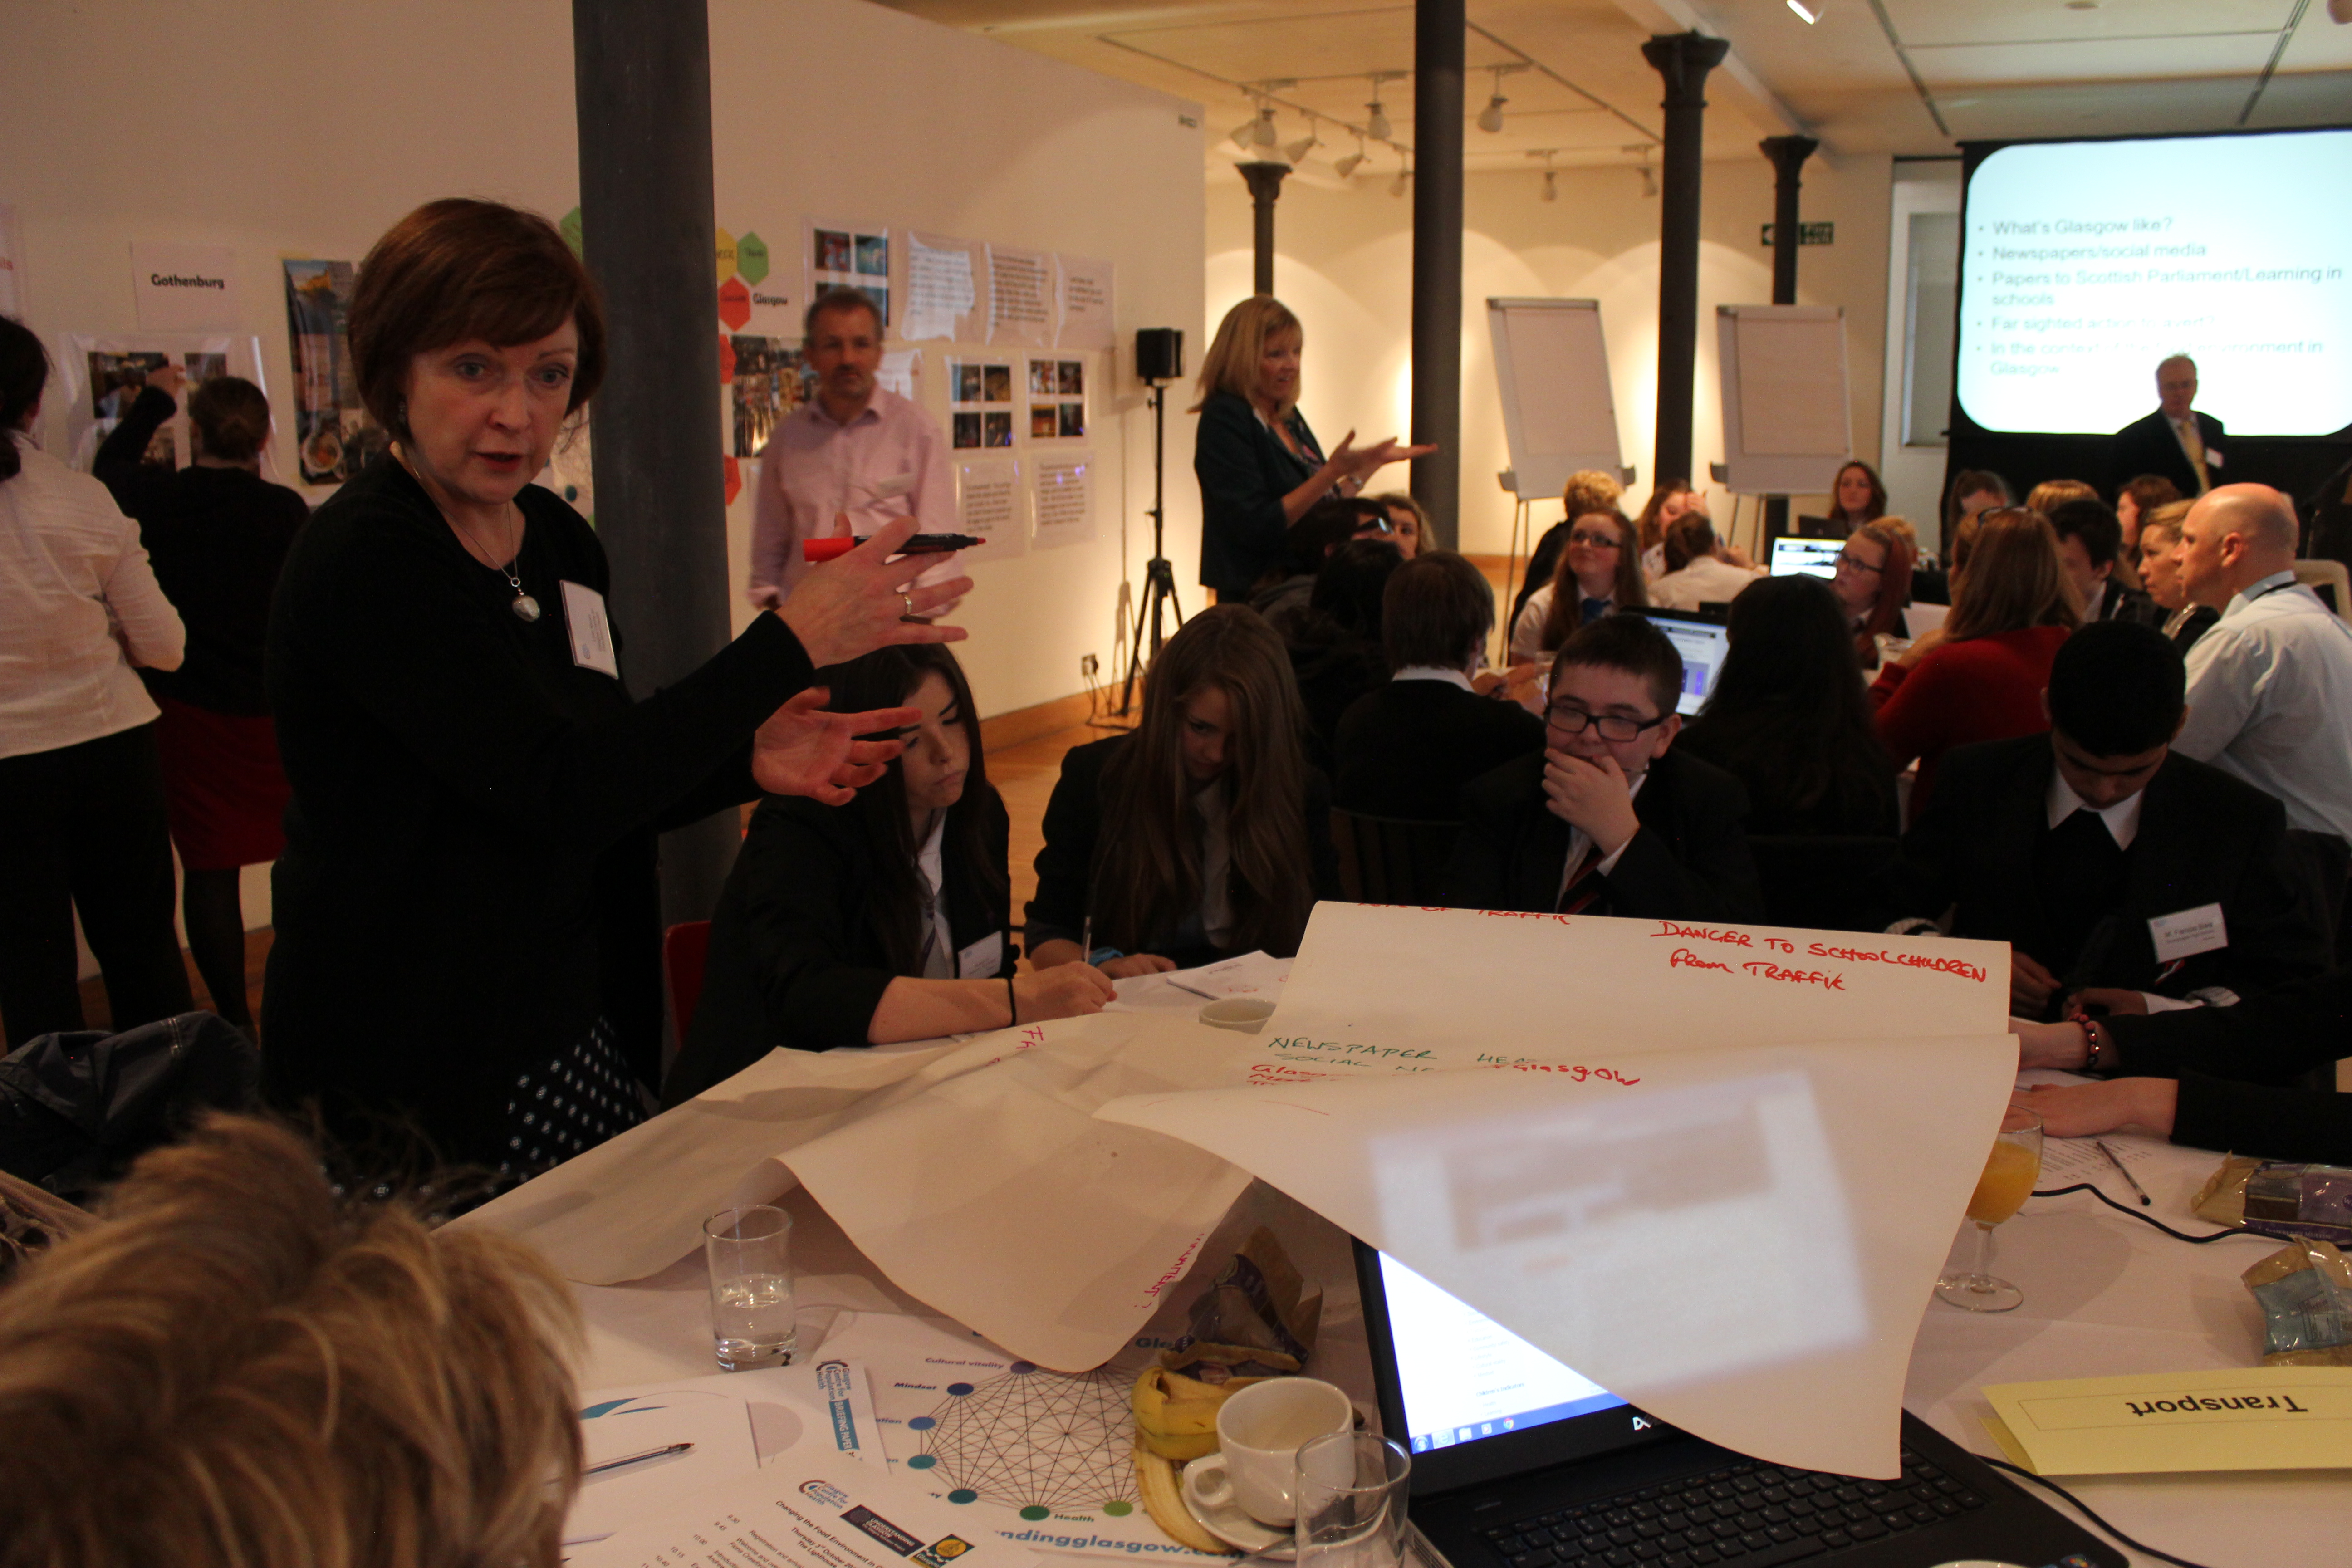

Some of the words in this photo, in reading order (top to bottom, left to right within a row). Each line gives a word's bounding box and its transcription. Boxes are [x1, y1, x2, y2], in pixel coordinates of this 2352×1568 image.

[1993, 221, 2050, 235] What's
[2055, 220, 2128, 236] Glasgow
[2133, 217, 2172, 232] like?
[1992, 245, 2149, 261] Newspapers/social
[2154, 243, 2207, 257] media
[151, 273, 225, 290] Gothenburg
[1992, 272, 2051, 287] Papers
[2055, 272, 2071, 285] to
[2076, 271, 2142, 285] Scottish
[2147, 267, 2322, 283] Parliament/Learning
[2327, 266, 2342, 280] in
[753, 293, 788, 305] Glasgow
[1992, 294, 2054, 305] schools
[1992, 317, 2018, 330] Far
[2024, 317, 2082, 333] sighted
[1991, 343, 2005, 354] In
[2010, 343, 2035, 354] the
[2042, 343, 2099, 353] context
[2198, 342, 2303, 352] environment
[2308, 341, 2323, 352] in
[1991, 362, 2060, 376] Glasgow
[1650, 920, 1753, 947] DANGER
[1764, 938, 1794, 954] TO
[1269, 1037, 1437, 1059] NEWSPAPER
[1274, 1054, 1372, 1067] SOCIAL
[924, 1357, 966, 1367] Cultural
[968, 1359, 1004, 1369] vitality
[894, 1382, 936, 1391] Mindset
[1476, 1388, 1499, 1397] Children's
[1500, 1382, 1525, 1392] Indicators
[2124, 1395, 2309, 1419] Transport
[834, 1401, 848, 1431] BRIEFING
[841, 1431, 853, 1450] PAPER
[1054, 1513, 1094, 1523] Health
[693, 1534, 708, 1545] 10.00
[775, 1499, 803, 1522] Changing
[803, 1517, 813, 1529] the
[814, 1525, 830, 1539] Food
[829, 1536, 867, 1563] Environment
[791, 1527, 815, 1545] Thursday
[736, 1537, 759, 1556] Welcome
[749, 1529, 778, 1553] Registration
[807, 1548, 838, 1568] Lighthouse
